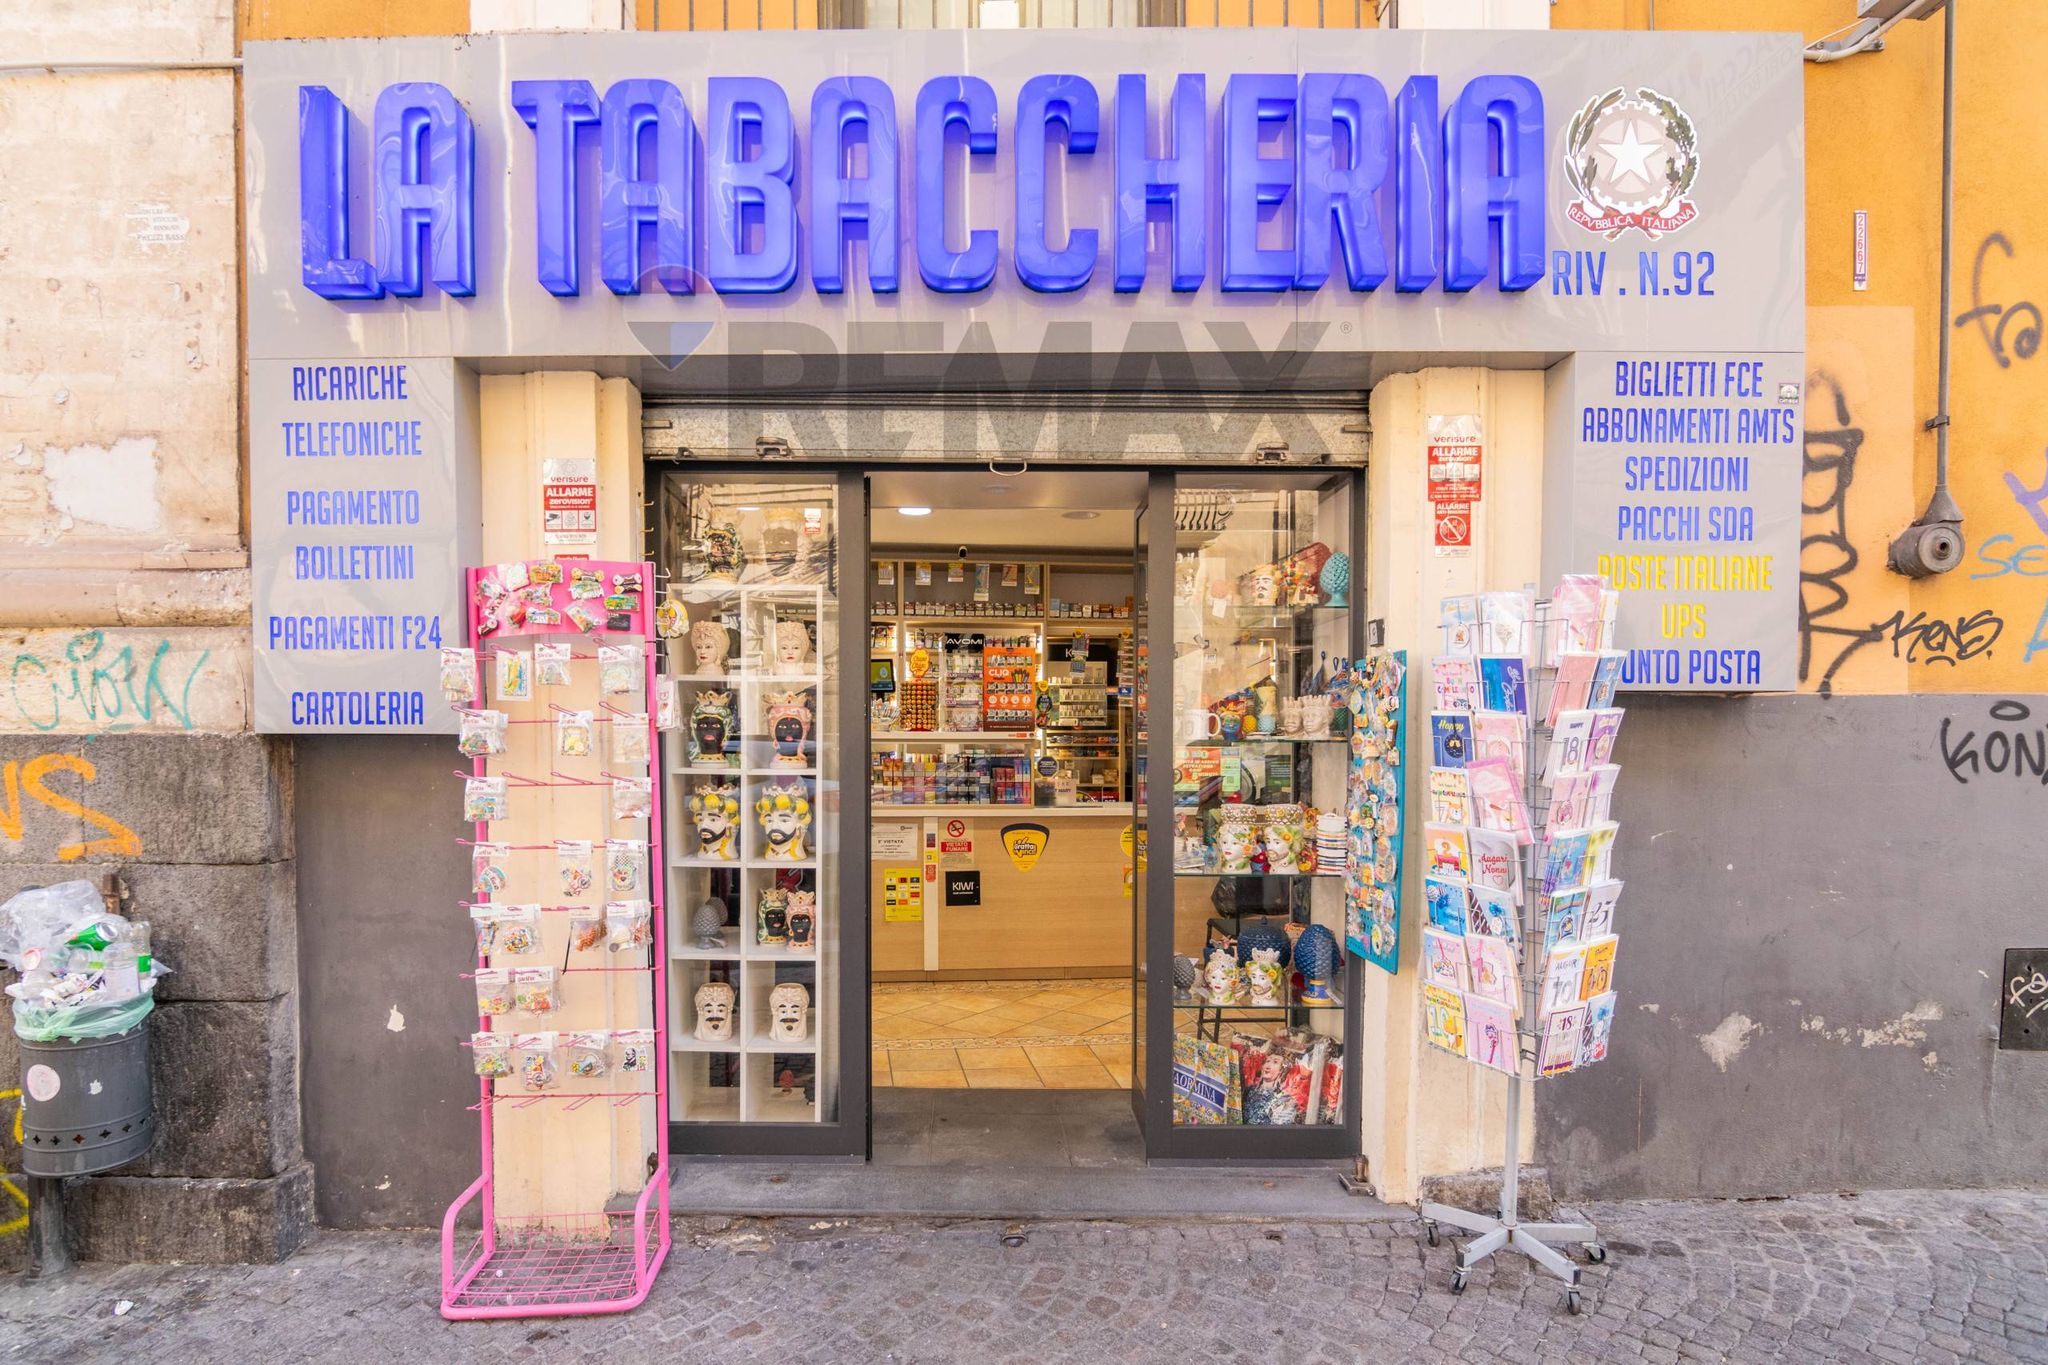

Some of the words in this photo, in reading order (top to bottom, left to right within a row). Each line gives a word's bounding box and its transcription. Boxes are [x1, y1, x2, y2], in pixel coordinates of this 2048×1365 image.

[300, 82, 476, 300] LA
[511, 73, 1546, 298] TABACCHERIA
[1568, 205, 1635, 230] REPVBBLICA
[1641, 207, 1696, 229] ITALIANA
[1552, 250, 1607, 296] RIV
[1638, 251, 1715, 296] N.92
[292, 365, 408, 401] RICARICHE
[1615, 361, 1717, 397] BIGLIETTI
[1724, 361, 1764, 397] FCE
[282, 421, 423, 457] TELEFONICHE
[1582, 408, 1731, 444] ABBONAMENTI
[1737, 408, 1795, 444] AMTS
[1432, 447, 1478, 456] ALLARME
[546, 487, 593, 497] ALLARME
[550, 475, 589, 483] verisure
[1625, 456, 1749, 492] SPEDIZIONI
[287, 490, 420, 526] PAGAMENTO
[1617, 506, 1700, 542] PACCHI
[1708, 506, 1754, 541] SDA
[295, 545, 415, 581] BOLLETTINI
[1674, 555, 1774, 592] ITALIANE
[269, 616, 395, 651] PAGAMENTI
[402, 615, 443, 650] F24
[1661, 603, 1707, 639] UPS
[988, 668, 1010, 677] CLIO
[1621, 650, 1680, 685] UNTO
[1688, 650, 1761, 685] POSTA
[291, 691, 425, 726] CARTOLERIA
[952, 881, 974, 891] KIWI
[1173, 1072, 1217, 1103] AORMINA
